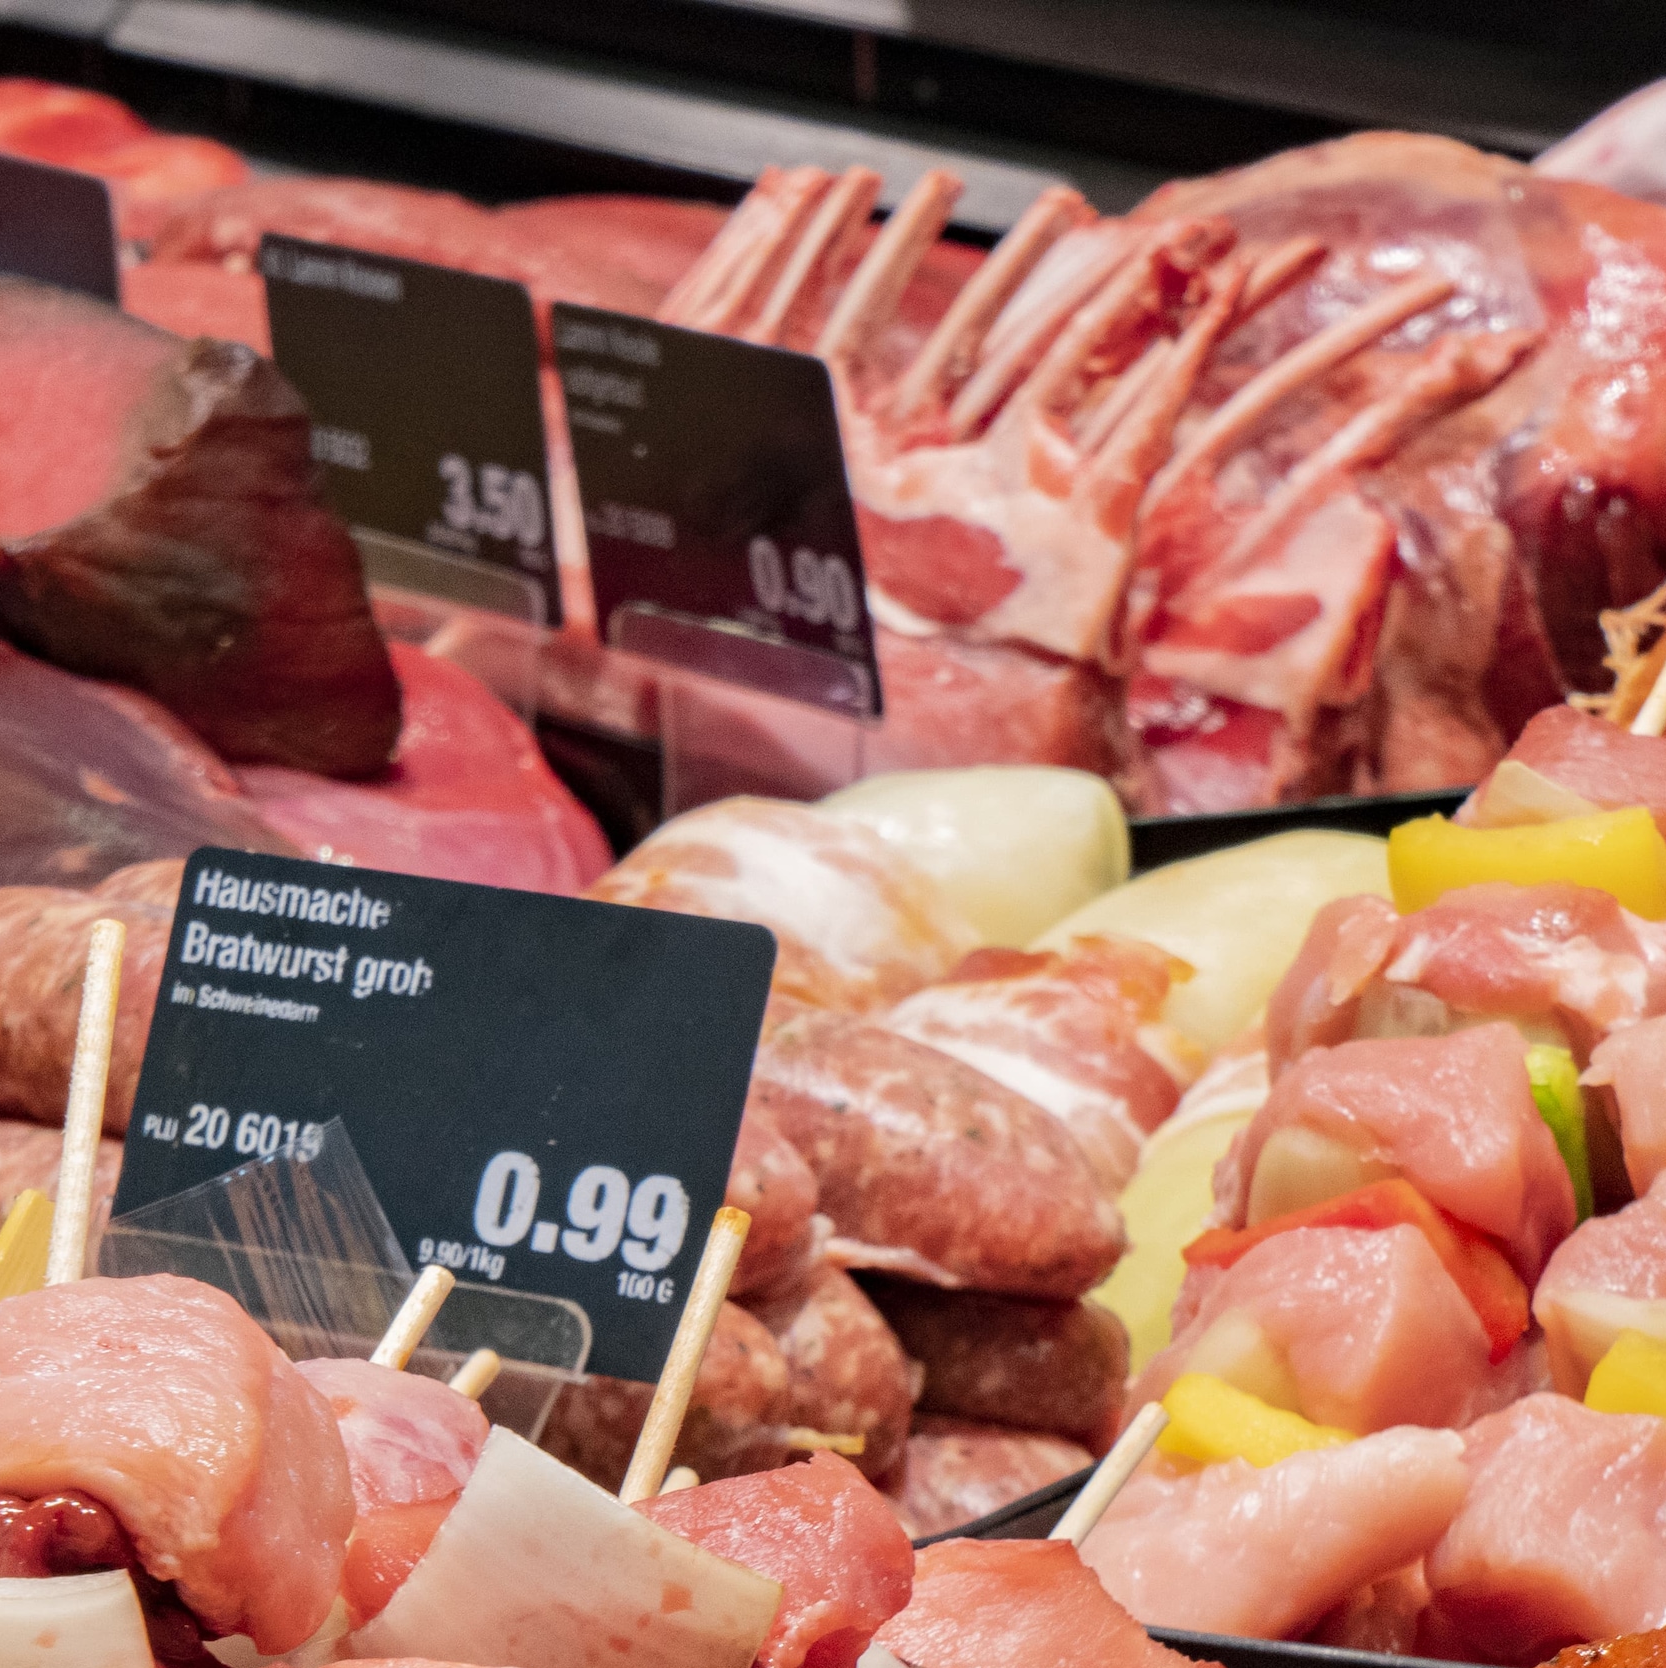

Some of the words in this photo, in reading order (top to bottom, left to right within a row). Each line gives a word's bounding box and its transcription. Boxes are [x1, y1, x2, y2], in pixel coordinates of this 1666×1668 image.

[194, 868, 391, 929] Hausmache
[182, 921, 349, 983] Bratwurst
[143, 1113, 180, 1142] PLU
[183, 1104, 231, 1150] 20
[473, 1151, 690, 1272] 0.99
[617, 1271, 655, 1301] 100
